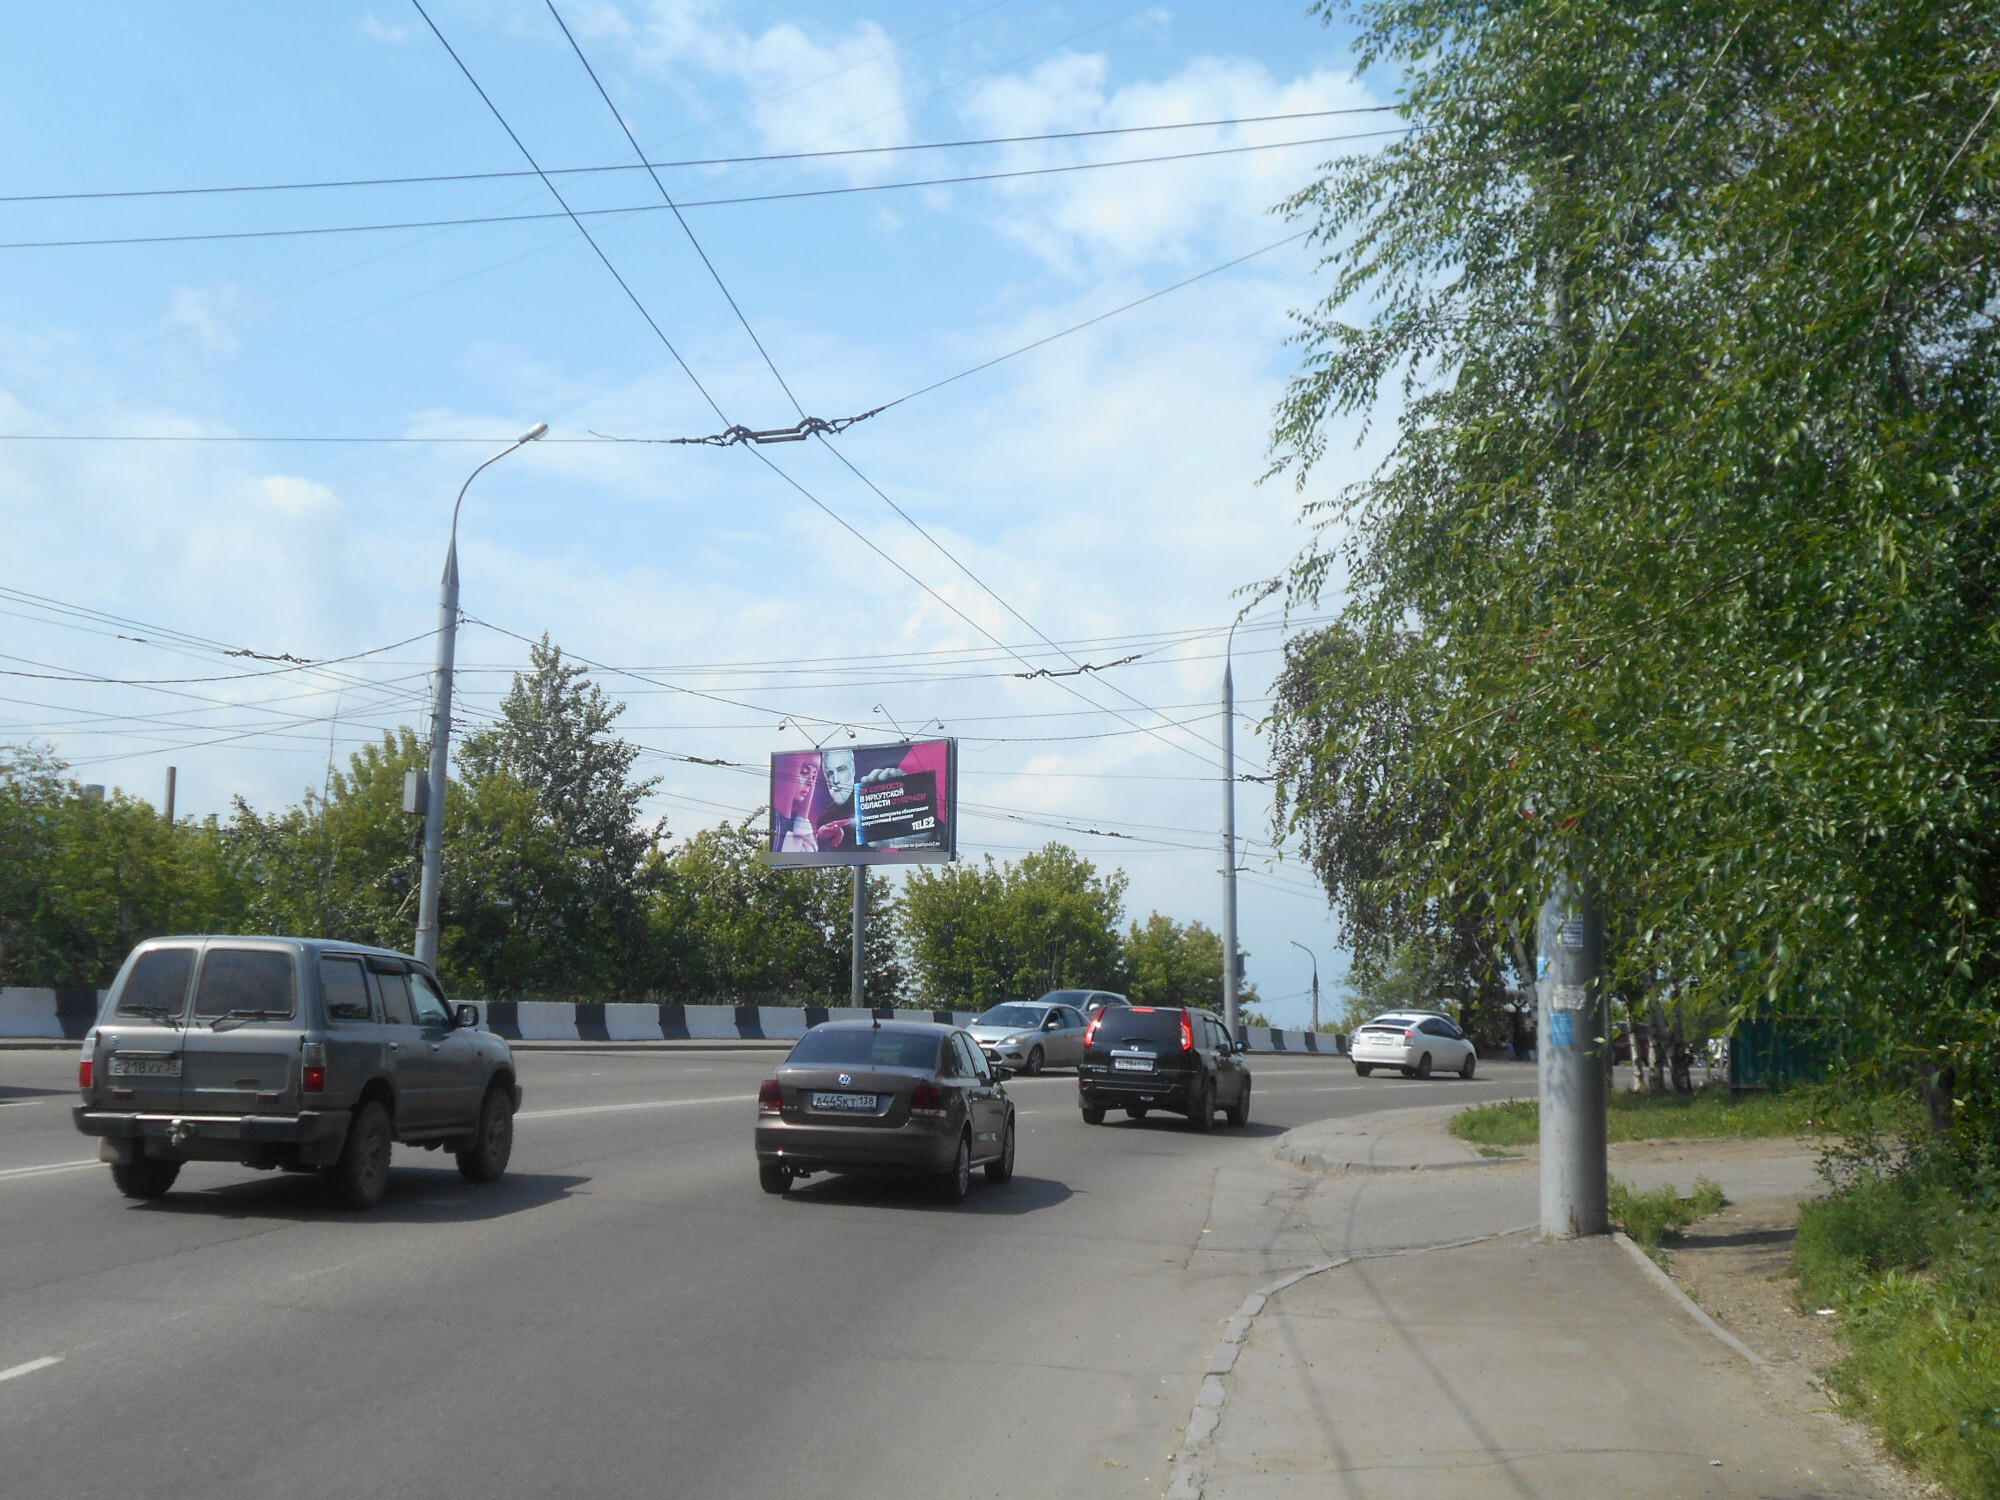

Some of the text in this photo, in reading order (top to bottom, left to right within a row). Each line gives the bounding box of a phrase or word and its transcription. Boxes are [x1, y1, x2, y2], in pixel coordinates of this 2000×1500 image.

[860, 788, 904, 803] В ИРКУТСКОЙ
[860, 799, 891, 811] ОБЛАСТИ
[912, 816, 935, 831] TELE2
